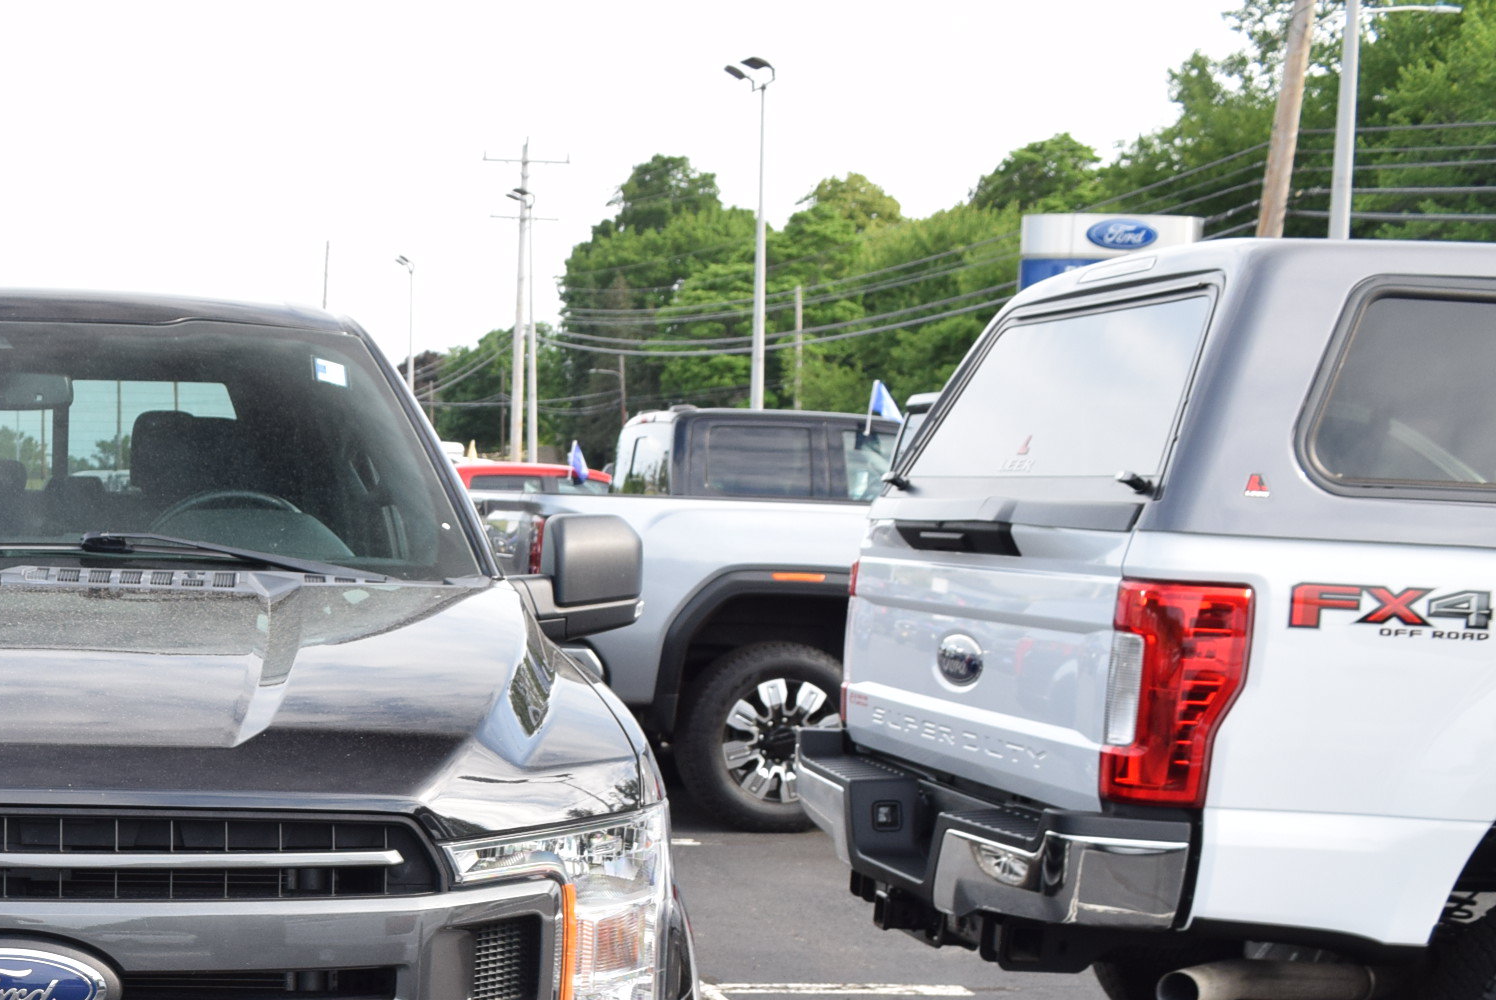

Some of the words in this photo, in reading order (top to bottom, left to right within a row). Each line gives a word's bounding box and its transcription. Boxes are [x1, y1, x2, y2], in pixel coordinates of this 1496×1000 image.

[1103, 223, 1147, 244] Ford
[1288, 582, 1492, 629] FX4
[1379, 628, 1422, 637] OFF
[1432, 631, 1489, 641] ROAD
[872, 708, 955, 746] SUPER
[962, 731, 1047, 769] DUTY
